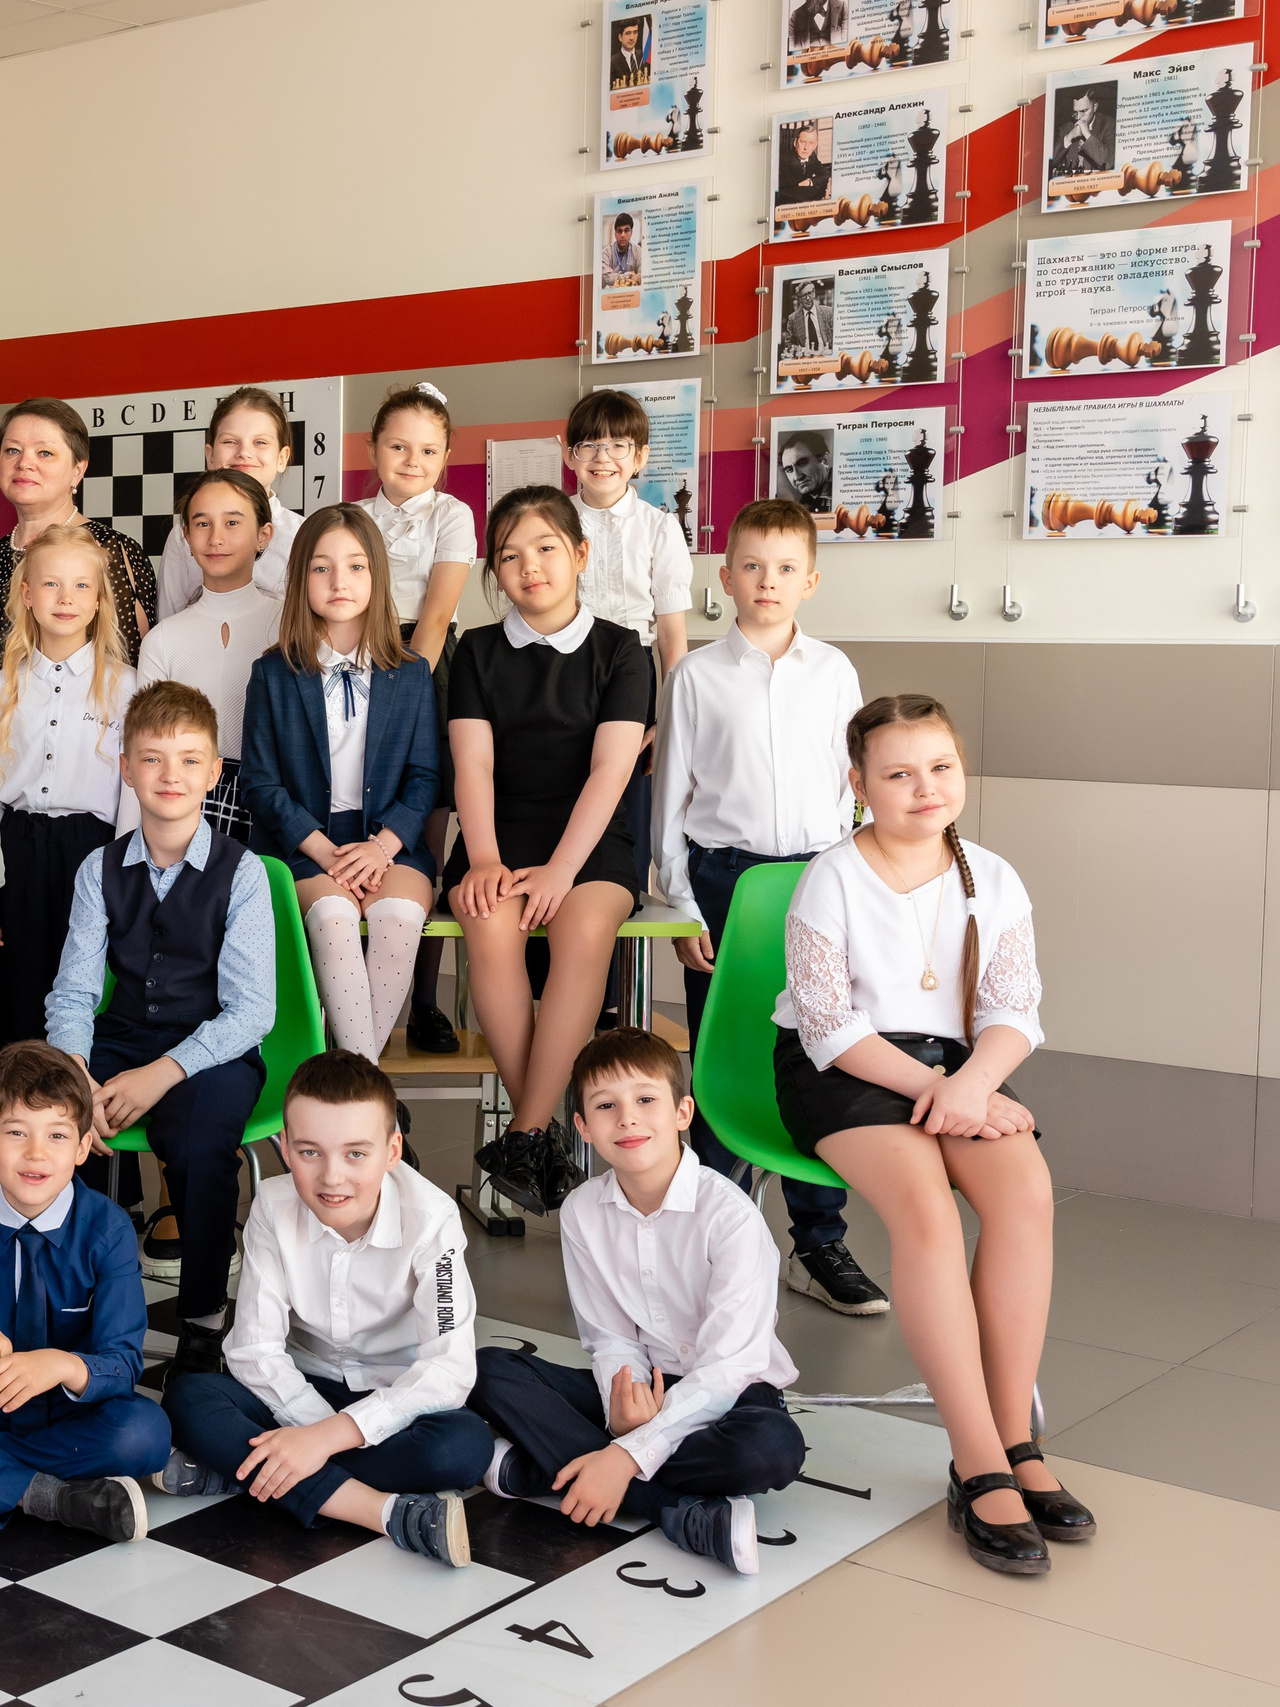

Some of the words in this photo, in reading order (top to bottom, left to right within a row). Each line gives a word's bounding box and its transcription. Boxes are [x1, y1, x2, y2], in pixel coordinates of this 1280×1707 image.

[1133, 70, 1161, 79] Макс
[1168, 65, 1195, 74] Эйве
[834, 107, 886, 120] Александр
[888, 101, 924, 111] Алехин
[617, 195, 657, 204] Вишванатан
[1037, 255, 1084, 265] Шахматы
[1100, 252, 1118, 260] это
[1120, 250, 1133, 258] по
[1135, 247, 1168, 257] форме
[838, 266, 878, 277] Василий
[881, 263, 923, 272] Смыслов
[1051, 263, 1115, 275] содержанию
[1045, 279, 1057, 287] по
[1060, 275, 1114, 286] трудности
[1117, 269, 1174, 281] овладения
[1036, 288, 1065, 298] игрой
[1081, 285, 1114, 294] наука.
[1089, 307, 1116, 315] Тигран
[644, 395, 676, 403] Карлсен
[1033, 405, 1082, 413] НЕЗЫБЛЕМЫЕ
[1145, 400, 1184, 408] ШАХМАТЫ
[92, 408, 105, 428] B
[121, 404, 135, 426] C
[151, 402, 165, 423] D
[183, 400, 196, 421] E
[836, 423, 868, 431] Тигран
[871, 421, 914, 429] Петросян
[313, 432, 326, 456] 8
[313, 475, 325, 499] 7
[616, 1561, 707, 1599] 3
[504, 1619, 595, 1660] 4
